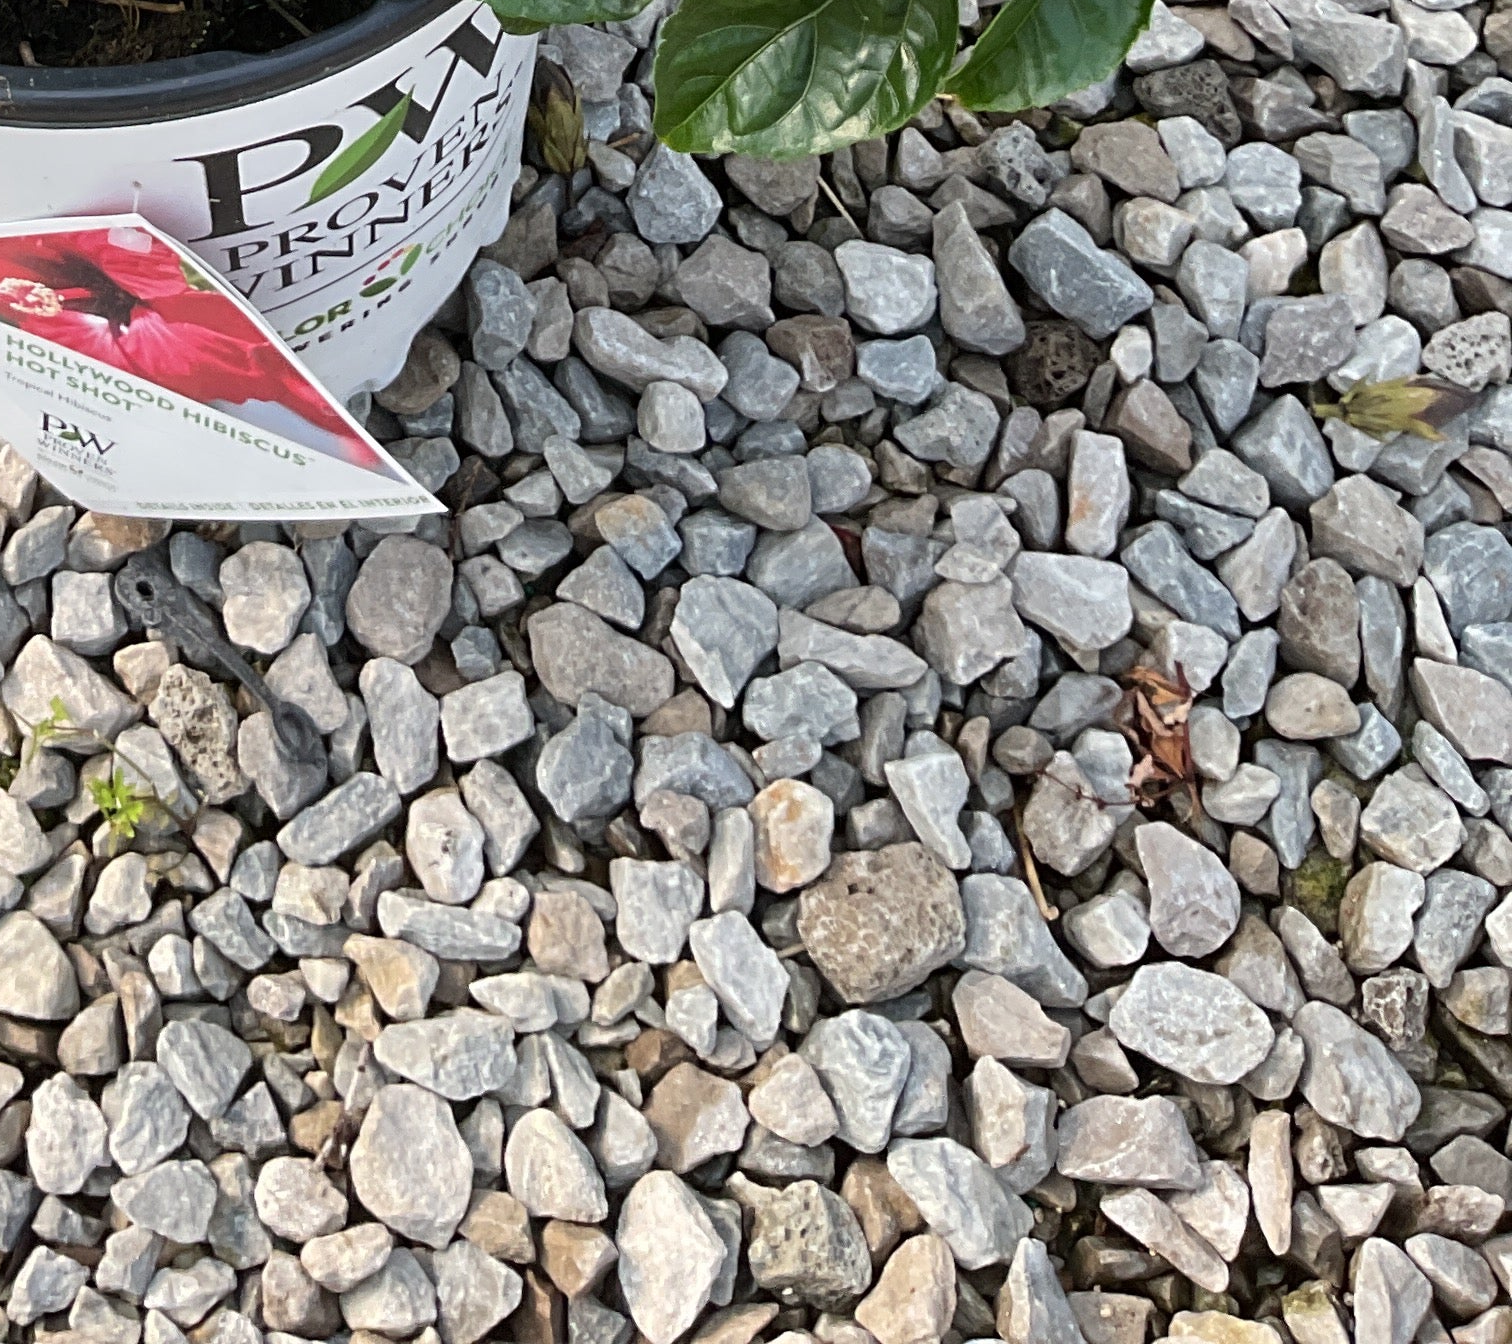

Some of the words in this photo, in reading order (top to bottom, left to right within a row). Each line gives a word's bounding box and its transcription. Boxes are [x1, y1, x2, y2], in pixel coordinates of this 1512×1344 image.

[172, 0, 504, 244] PW
[224, 62, 506, 274] PROVEN
[284, 299, 354, 342] LOR
[291, 278, 414, 354] WERING
[6, 349, 64, 381] HOT
[66, 375, 136, 412] SHOT
[6, 333, 175, 412] HOLLYWOOD
[182, 406, 308, 466] HIBISCUS
[40, 409, 118, 456] PW
